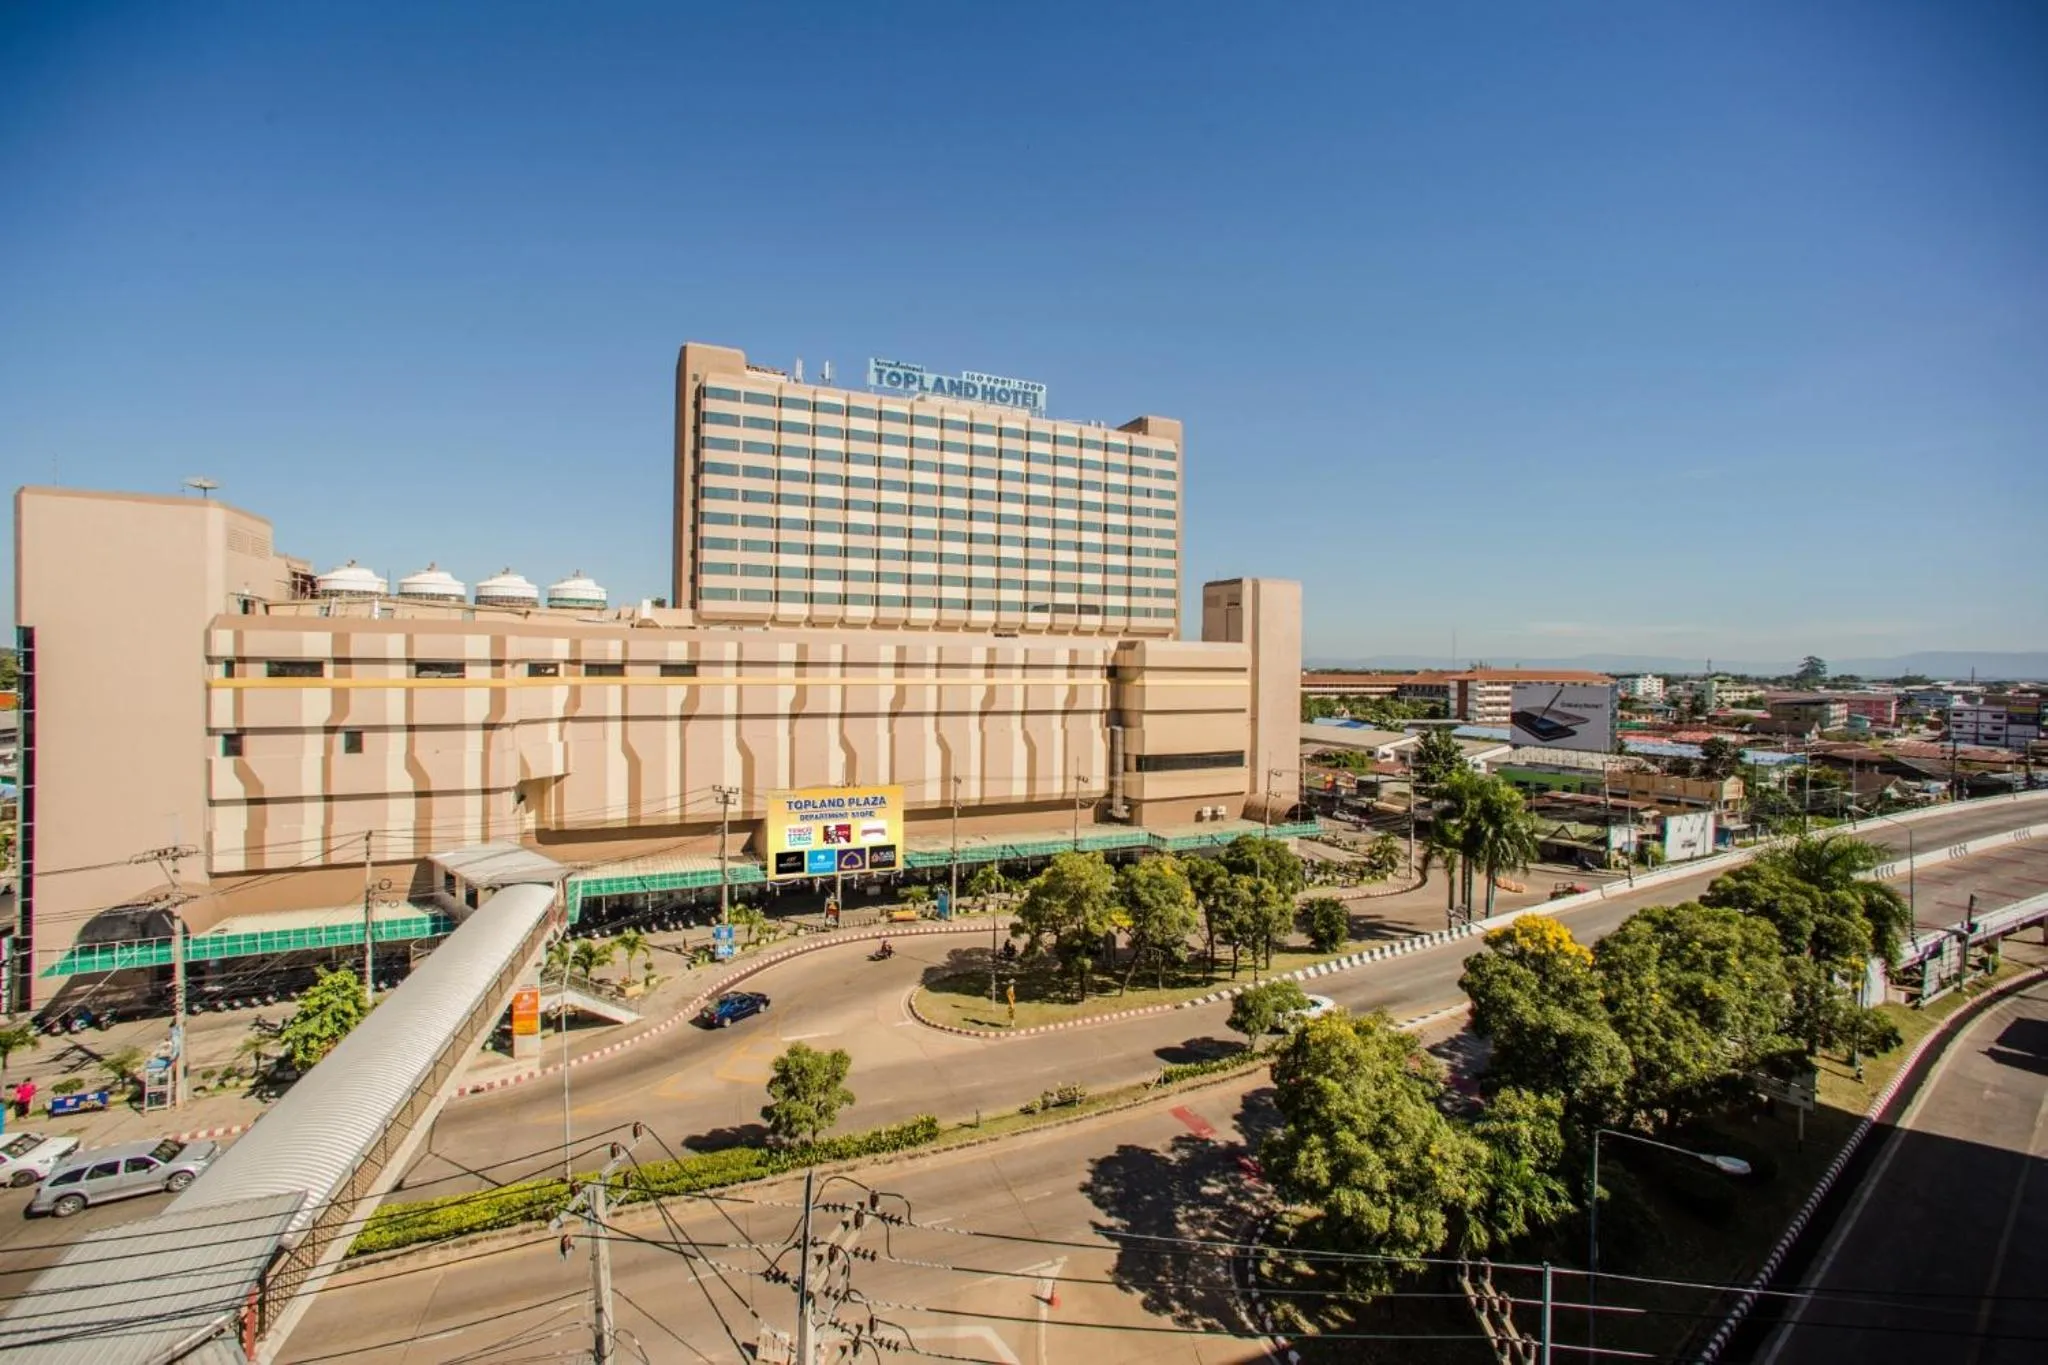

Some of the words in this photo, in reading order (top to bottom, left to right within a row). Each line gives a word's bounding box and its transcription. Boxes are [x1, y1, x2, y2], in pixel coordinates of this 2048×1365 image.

[874, 367, 978, 399] TOPLAND
[981, 384, 1038, 407] HOTEL
[786, 798, 845, 810] TOPLAND
[847, 796, 886, 807] PLAZA
[799, 811, 848, 821] DEPARTMENT
[851, 810, 875, 818] STORE
